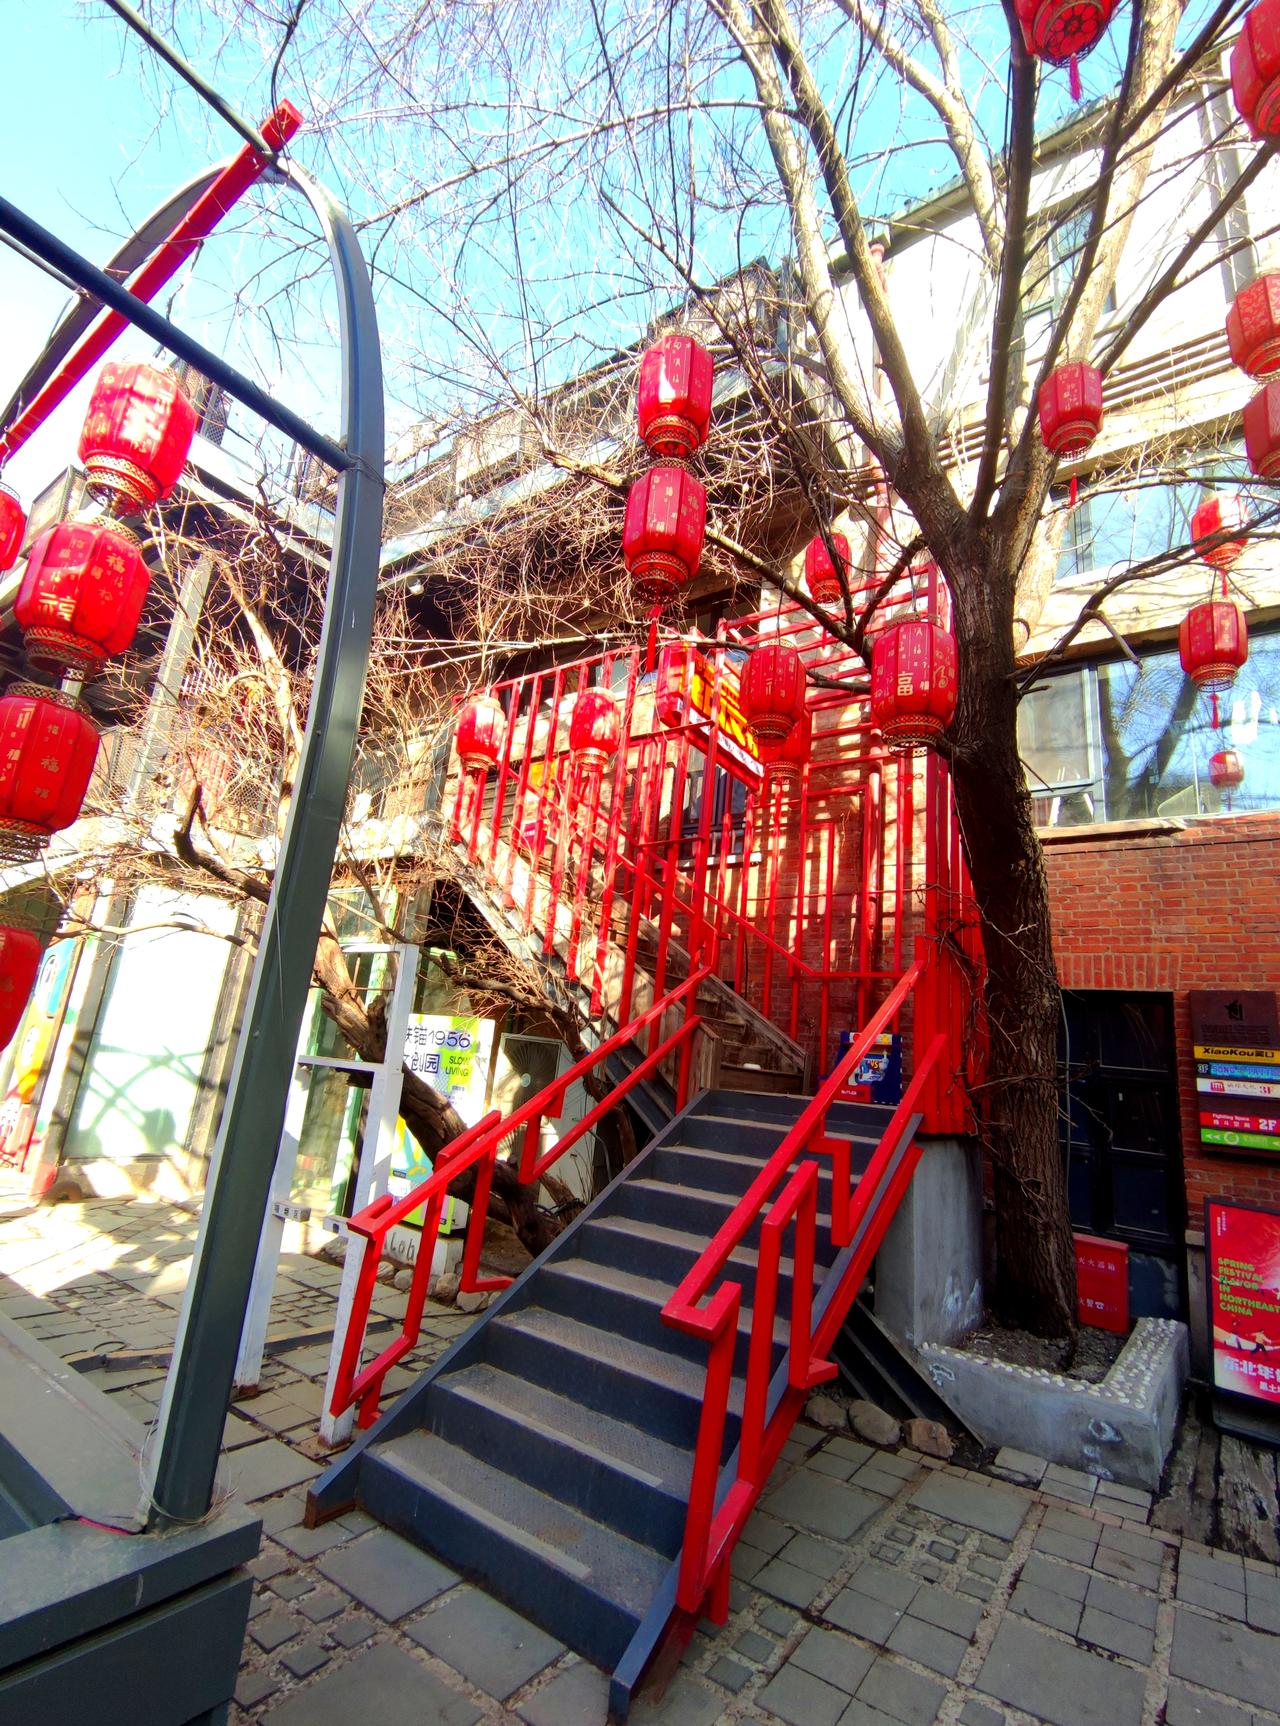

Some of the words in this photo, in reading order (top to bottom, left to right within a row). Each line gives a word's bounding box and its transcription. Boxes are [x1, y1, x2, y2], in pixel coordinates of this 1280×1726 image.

[449, 1055, 470, 1065] SLOW
[870, 1060, 878, 1069] VS
[445, 1067, 469, 1077] LIVING
[1259, 1118, 1277, 1131] 2F
[1218, 1257, 1255, 1271] SPRING
[1219, 1266, 1264, 1284] FESTIVAL
[1219, 1284, 1230, 1293] IN
[1220, 1293, 1280, 1314] NORTHEAST
[1220, 1302, 1254, 1317] CHINA
[1259, 1381, 1280, 1394] 黑土
